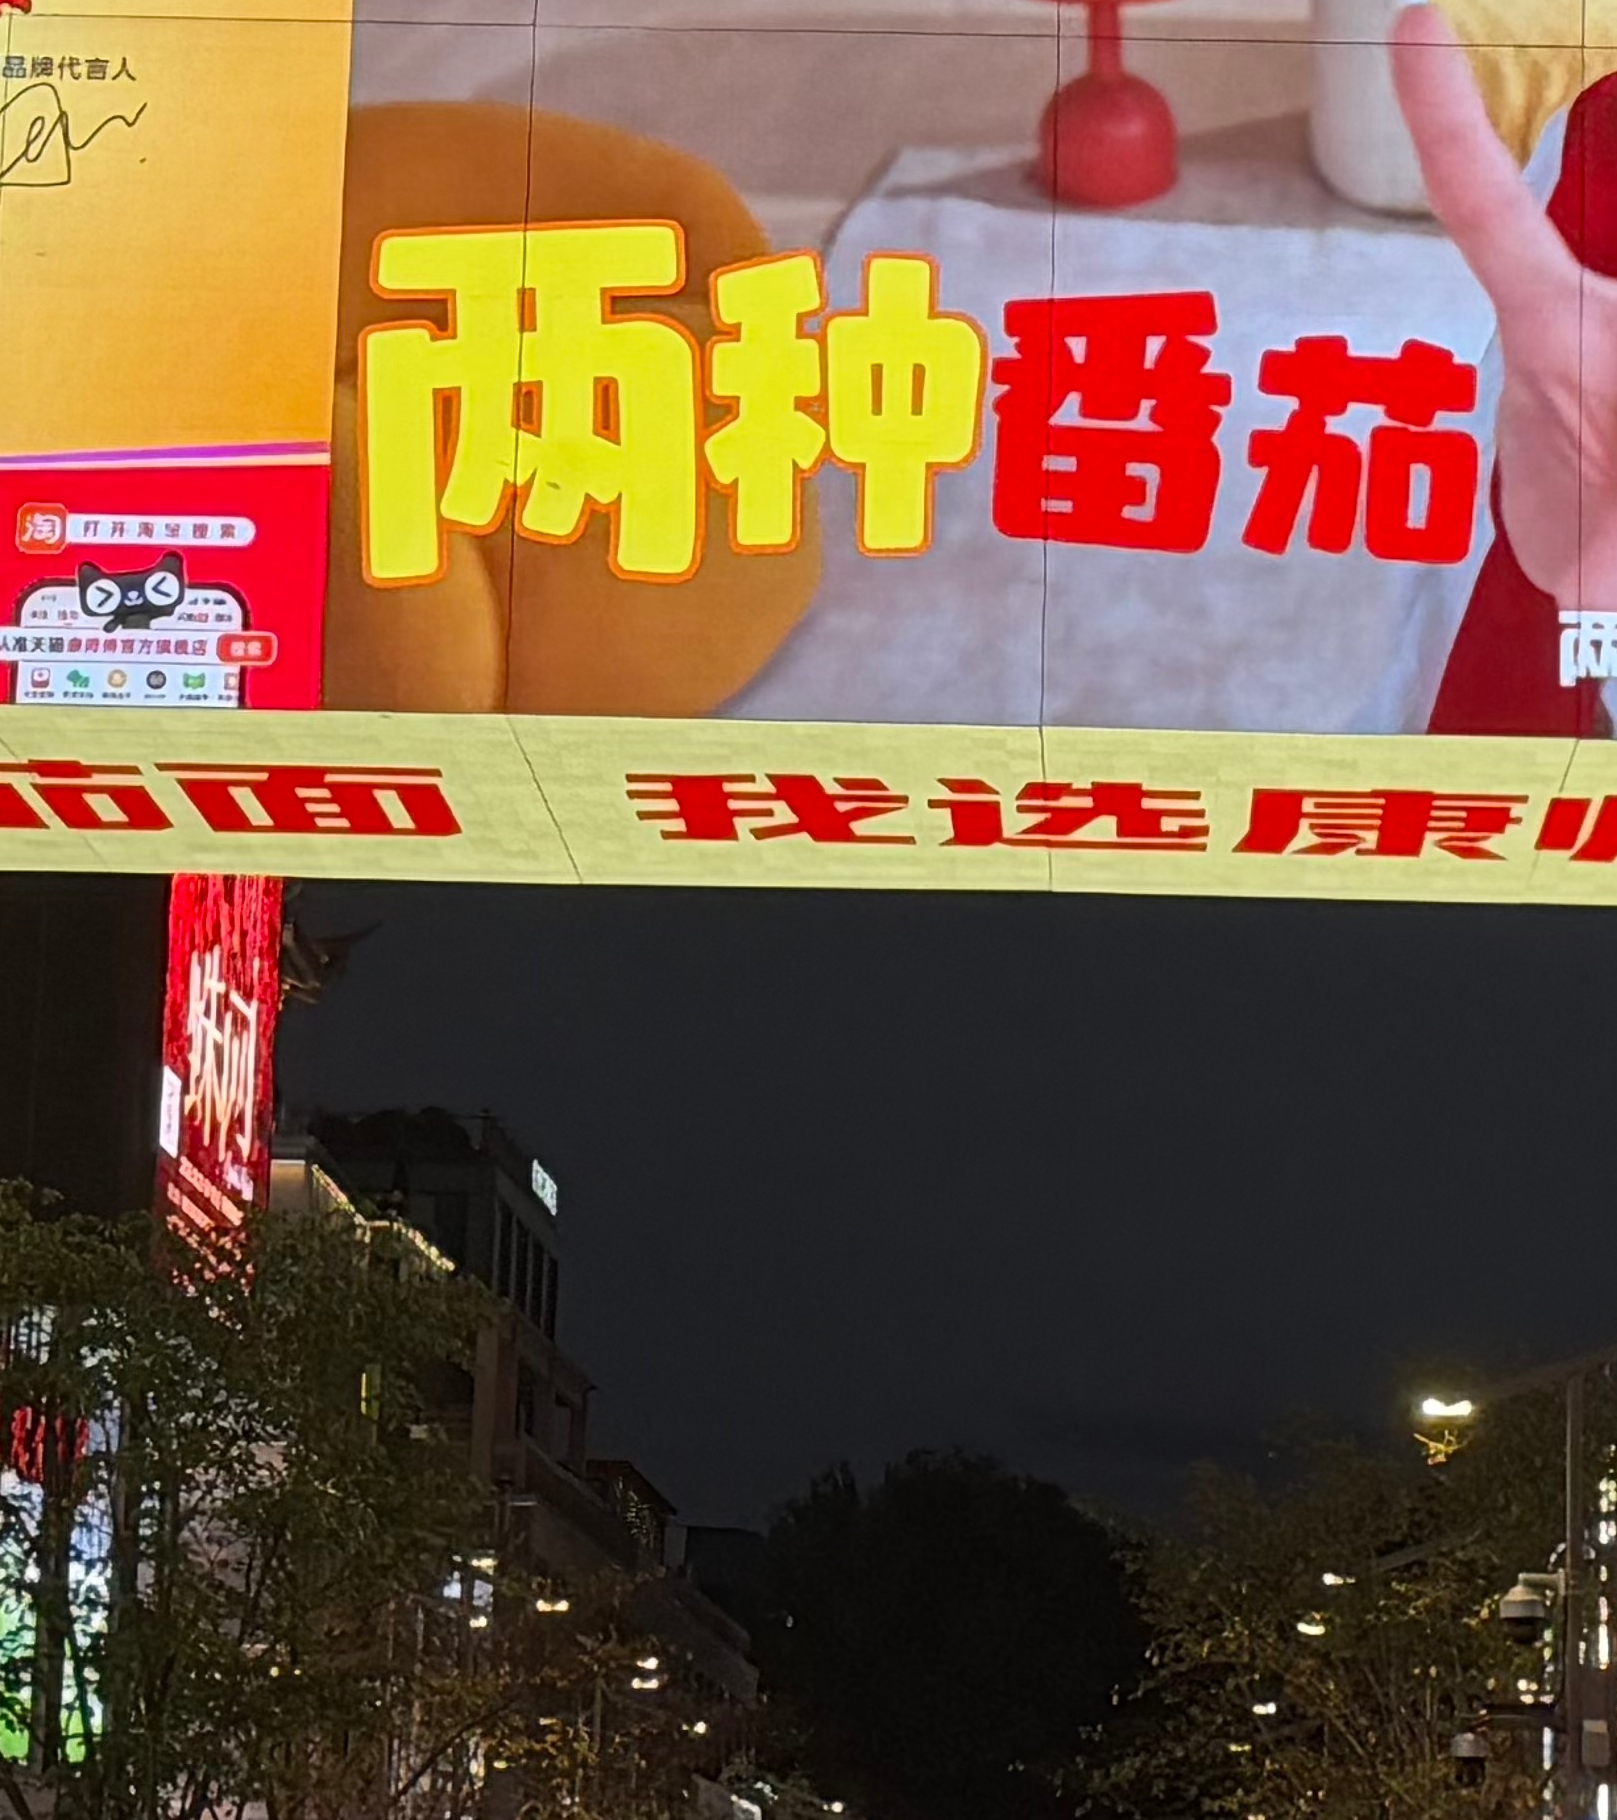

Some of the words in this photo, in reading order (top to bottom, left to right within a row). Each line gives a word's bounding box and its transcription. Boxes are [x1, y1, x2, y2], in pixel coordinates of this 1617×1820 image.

[361, 220, 1479, 587] 两种番茄
[21, 512, 61, 544] 淘
